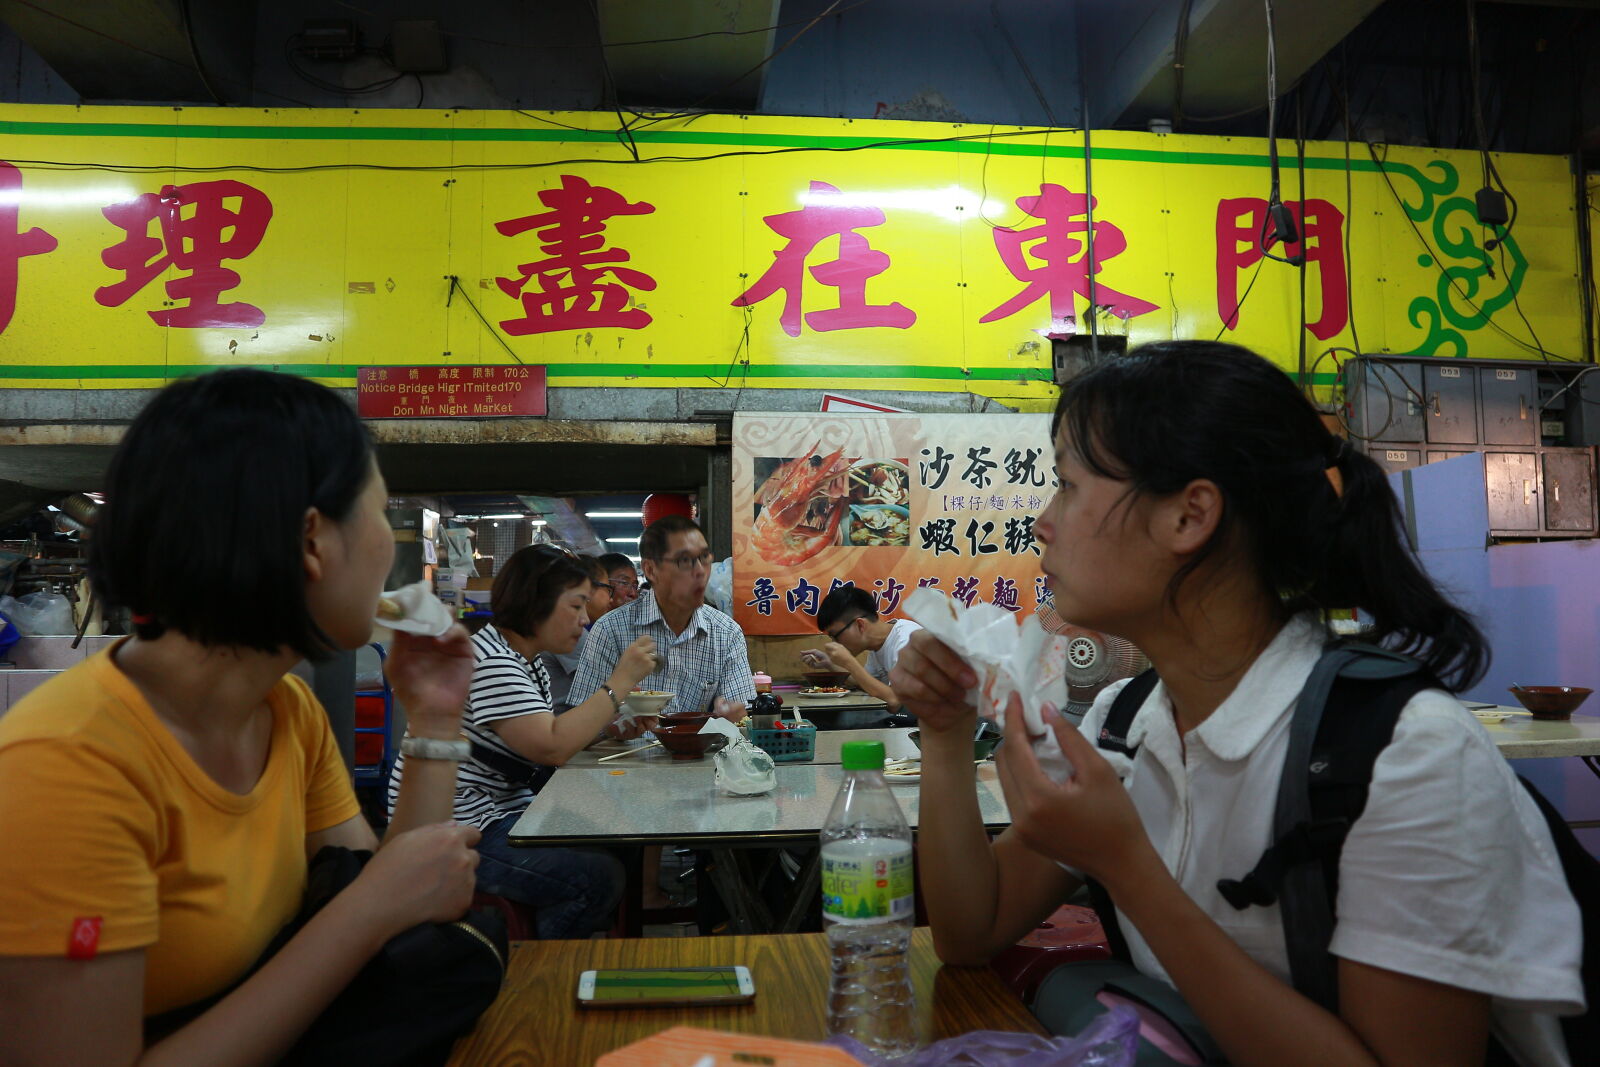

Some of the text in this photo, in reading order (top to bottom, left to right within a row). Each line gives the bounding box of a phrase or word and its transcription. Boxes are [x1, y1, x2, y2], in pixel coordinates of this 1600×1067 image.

[438, 367, 460, 379] 高度
[473, 367, 495, 378] 限制
[360, 383, 396, 393] Notice
[398, 383, 435, 395] Bridge
[393, 406, 414, 416] Don
[420, 405, 435, 415] Mn
[919, 446, 1059, 490] 沙茶魷
